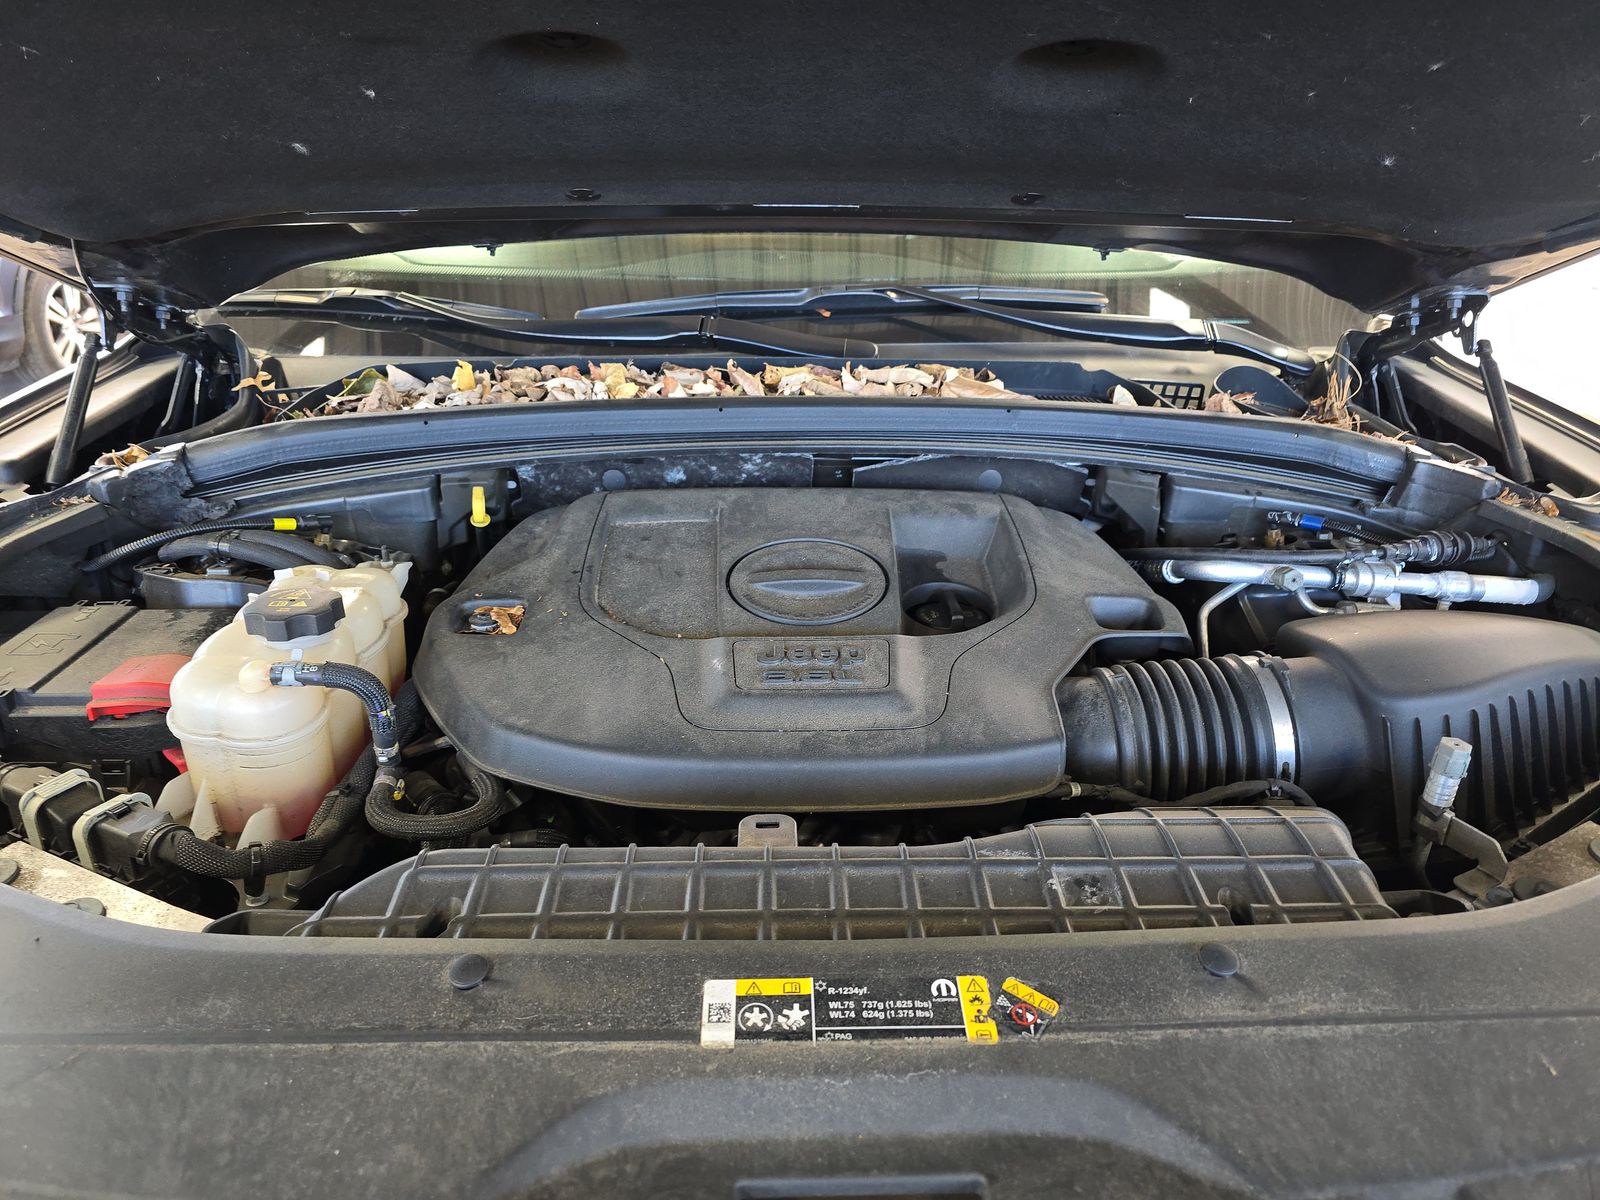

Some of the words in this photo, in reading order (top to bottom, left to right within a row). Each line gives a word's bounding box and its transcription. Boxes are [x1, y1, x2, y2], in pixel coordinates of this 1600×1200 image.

[757, 640, 866, 669] Jeep
[828, 1001, 855, 1009] WL75
[861, 1000, 884, 1010] 737g
[885, 1000, 913, 1010] (1.625
[914, 1000, 932, 1009] lbs)
[829, 1010, 856, 1018] WL74
[862, 1010, 885, 1019] 624g
[886, 1009, 914, 1019] (1.375
[915, 1009, 934, 1018] lbs)
[834, 1032, 853, 1040] PAG
